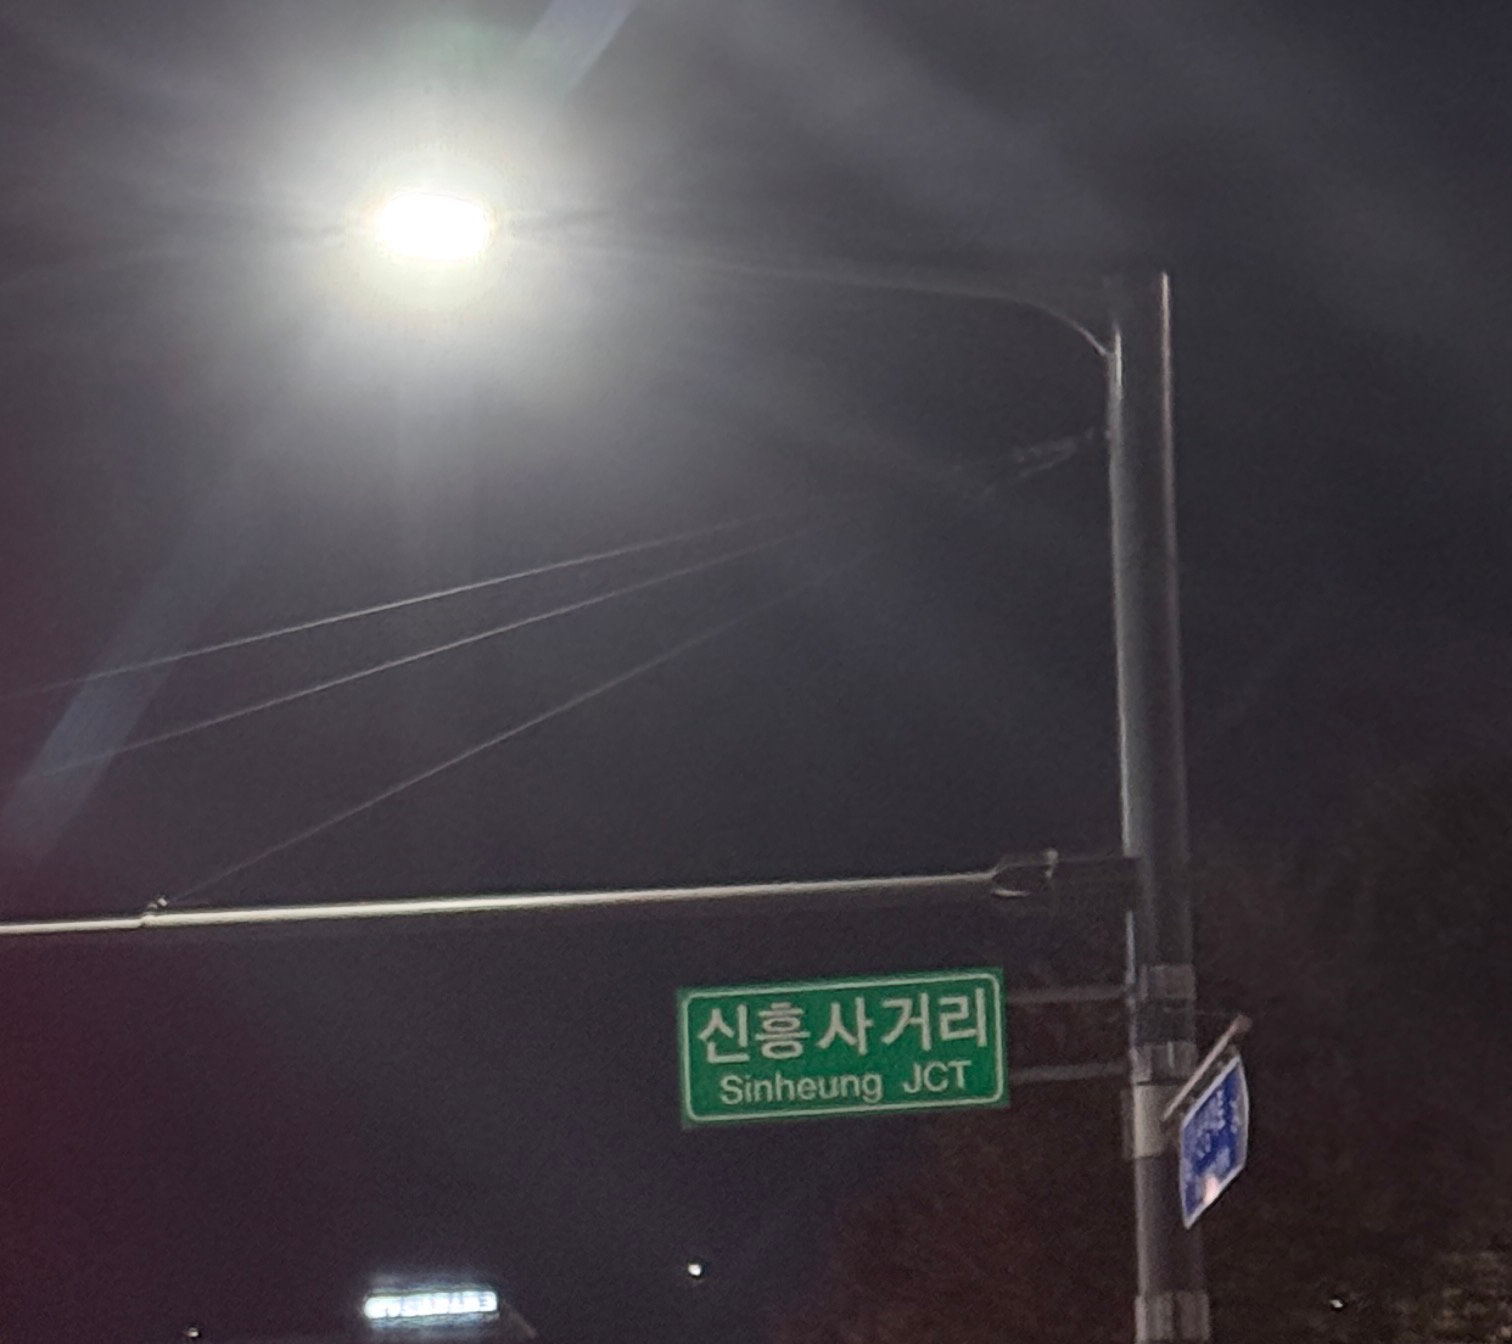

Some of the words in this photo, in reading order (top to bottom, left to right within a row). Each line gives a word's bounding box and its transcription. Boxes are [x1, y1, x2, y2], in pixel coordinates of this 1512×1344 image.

[697, 986, 988, 1065] 신흥사거리
[719, 1071, 883, 1107] Sinheung
[903, 1059, 972, 1095] JCT
